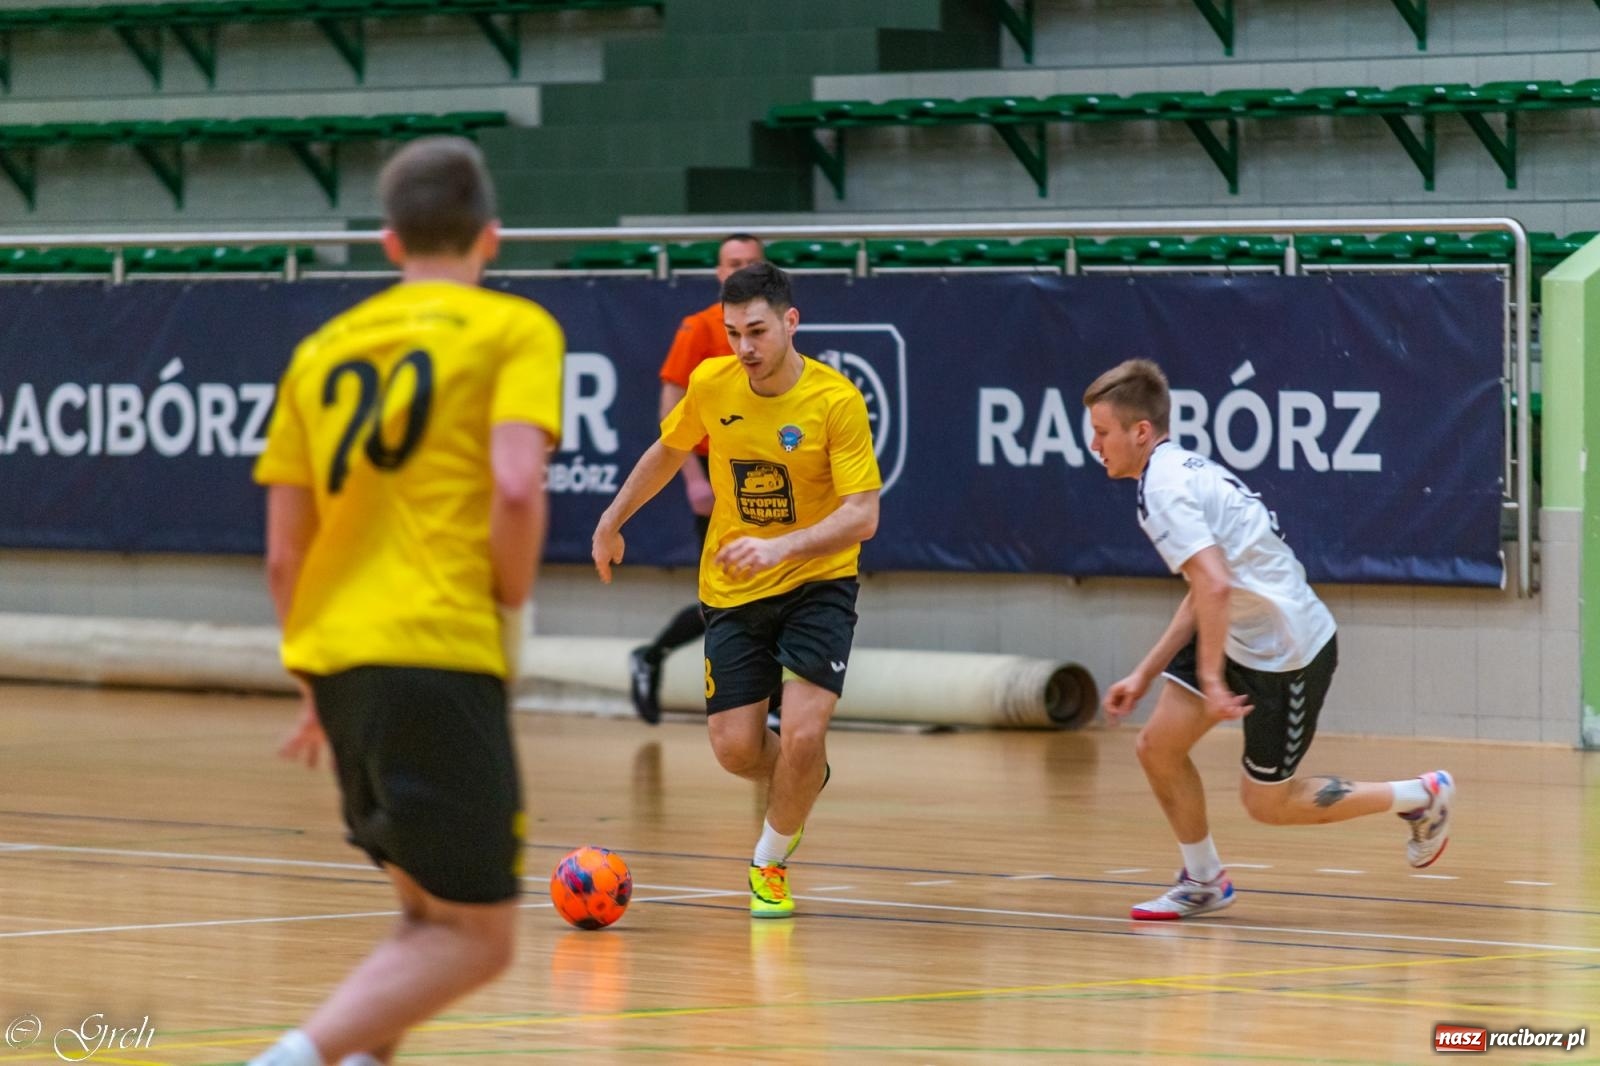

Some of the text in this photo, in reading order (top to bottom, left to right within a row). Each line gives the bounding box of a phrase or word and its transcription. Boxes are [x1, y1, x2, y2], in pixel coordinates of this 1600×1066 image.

[0, 356, 275, 458] ACIBÓRZ
[977, 359, 1382, 473] RABÓRZ
[542, 455, 618, 493] IBÓRZ
[741, 506, 789, 518] GARAGE
